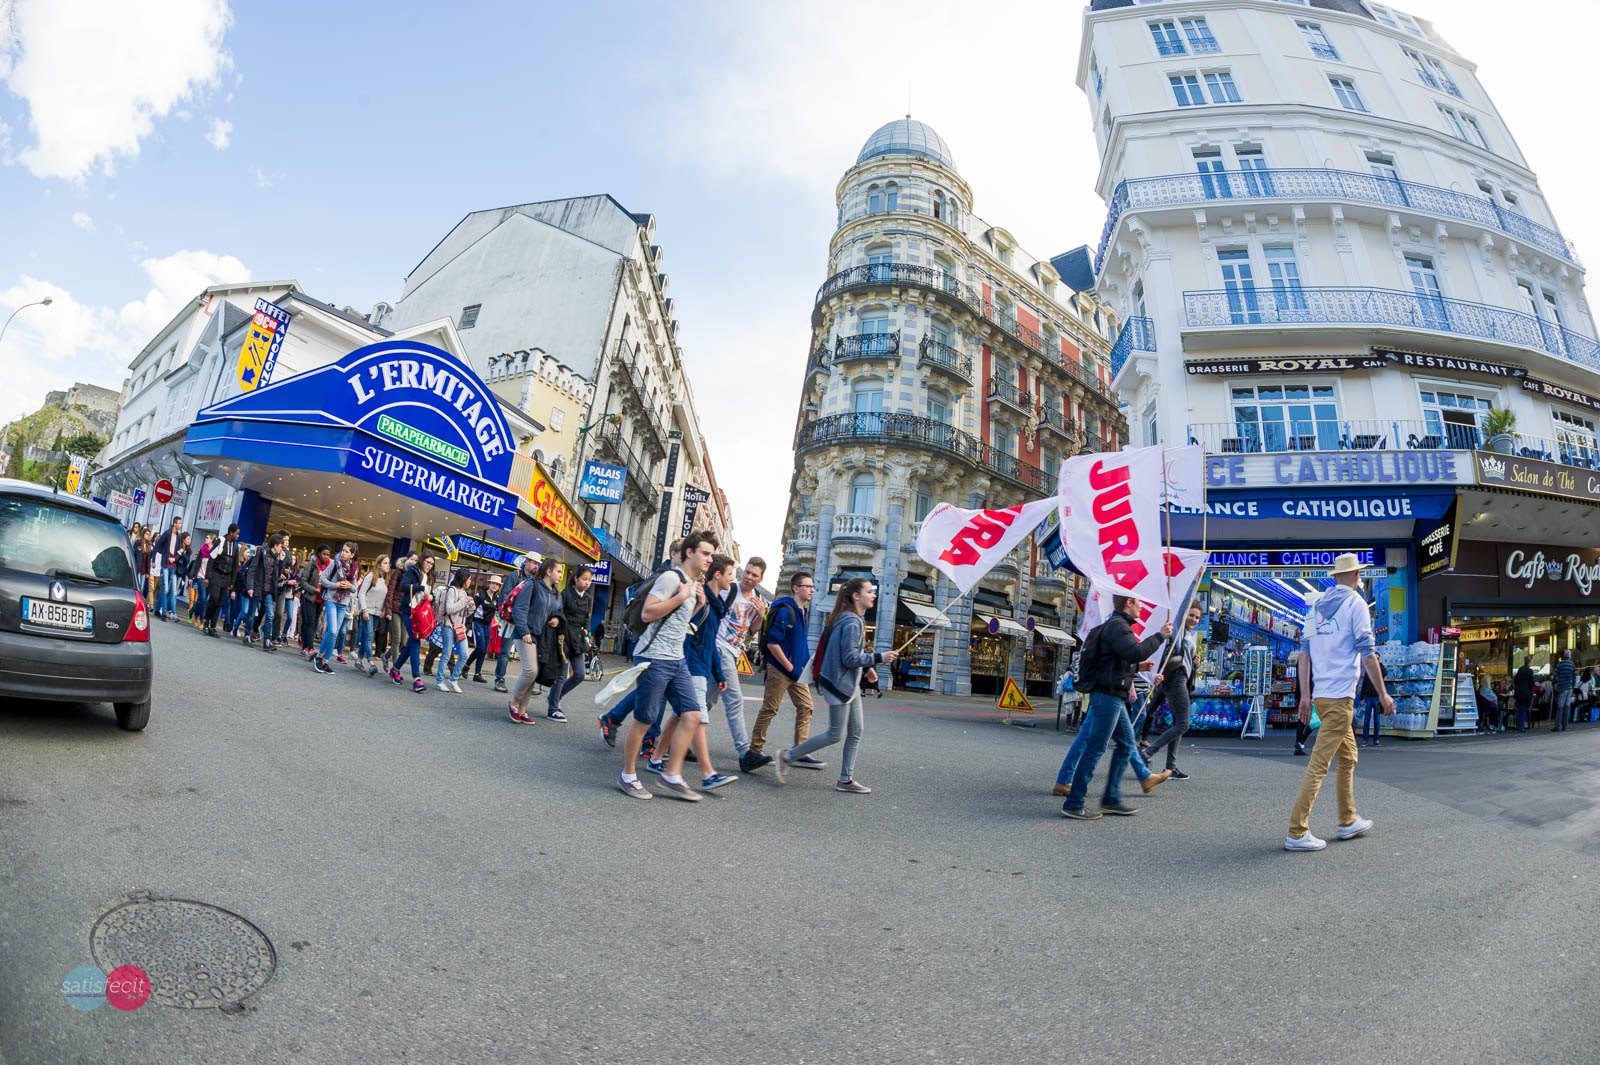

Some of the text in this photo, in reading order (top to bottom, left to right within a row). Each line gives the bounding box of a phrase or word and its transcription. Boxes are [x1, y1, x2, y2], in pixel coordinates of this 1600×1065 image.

[255, 299, 292, 324] BUFFET
[1189, 364, 1250, 374] BRASSERIE
[1257, 358, 1354, 372] ROYAL
[1404, 354, 1508, 376] RESTAURANT
[1523, 380, 1540, 392] CAFE
[1542, 383, 1591, 406] ROYAL
[347, 359, 504, 462] L'ERMITAGE
[380, 417, 469, 465] PARAPHARMACIE
[589, 465, 621, 480] PALAIS
[1274, 451, 1458, 484] CATHOLIQUE
[1510, 463, 1539, 485] Salon
[1542, 470, 1554, 487] de
[1557, 469, 1575, 491] Thé
[361, 446, 505, 517] SUPERMARKET
[582, 485, 621, 499] ROSAIRE
[598, 478, 608, 486] DU
[1281, 498, 1413, 517] CATHOLIQUE
[1089, 459, 1149, 591] JURA
[1421, 524, 1450, 546] BRASSERIE
[457, 536, 503, 561] NEGOZIO
[1428, 537, 1443, 557] CAFÉ
[1507, 550, 1600, 595] Café Roya
[105, 621, 120, 629] Clio
